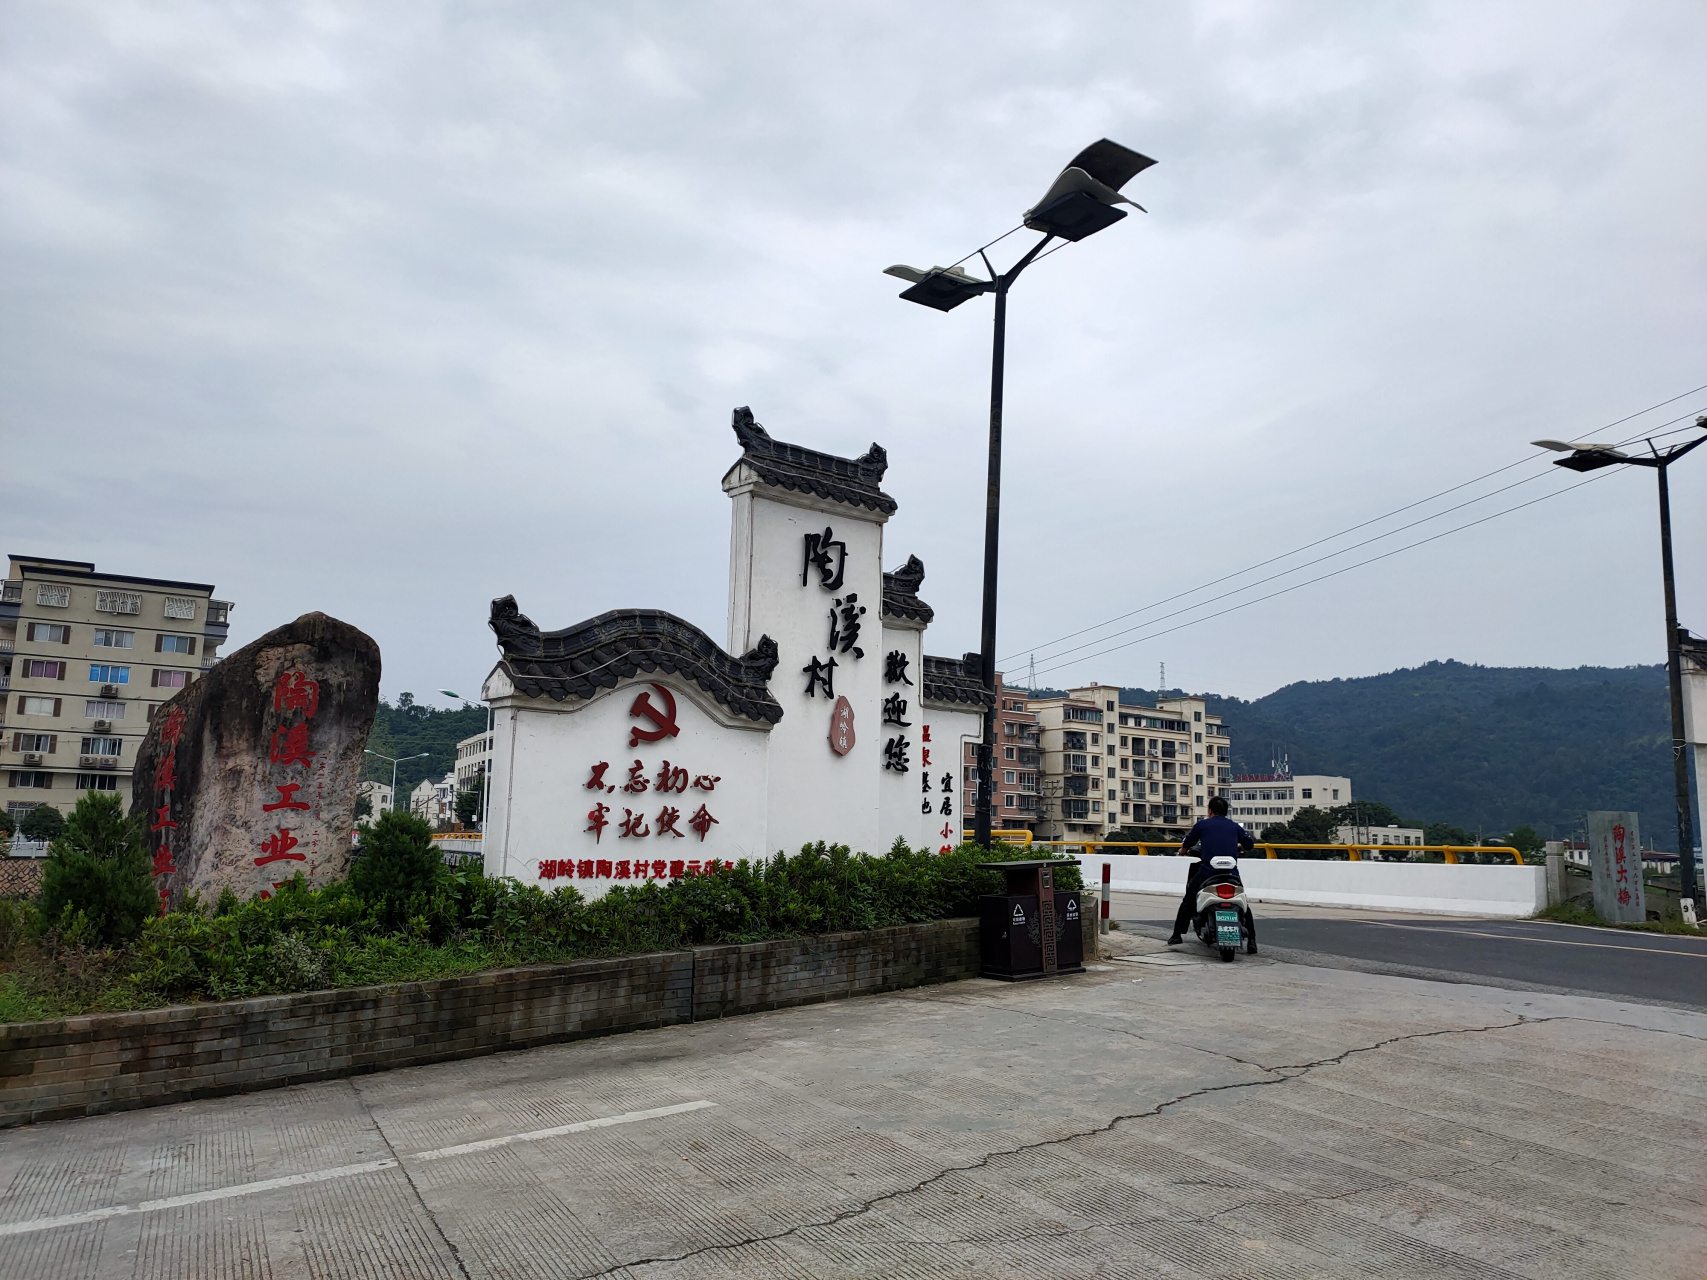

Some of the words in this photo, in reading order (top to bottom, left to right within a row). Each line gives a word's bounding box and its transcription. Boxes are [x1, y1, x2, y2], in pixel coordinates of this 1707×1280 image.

[803, 527, 866, 699] 陶溪村
[254, 671, 319, 900] 陶溪工业
[586, 760, 721, 793] 不忘初心
[587, 802, 719, 844] 牢记使命
